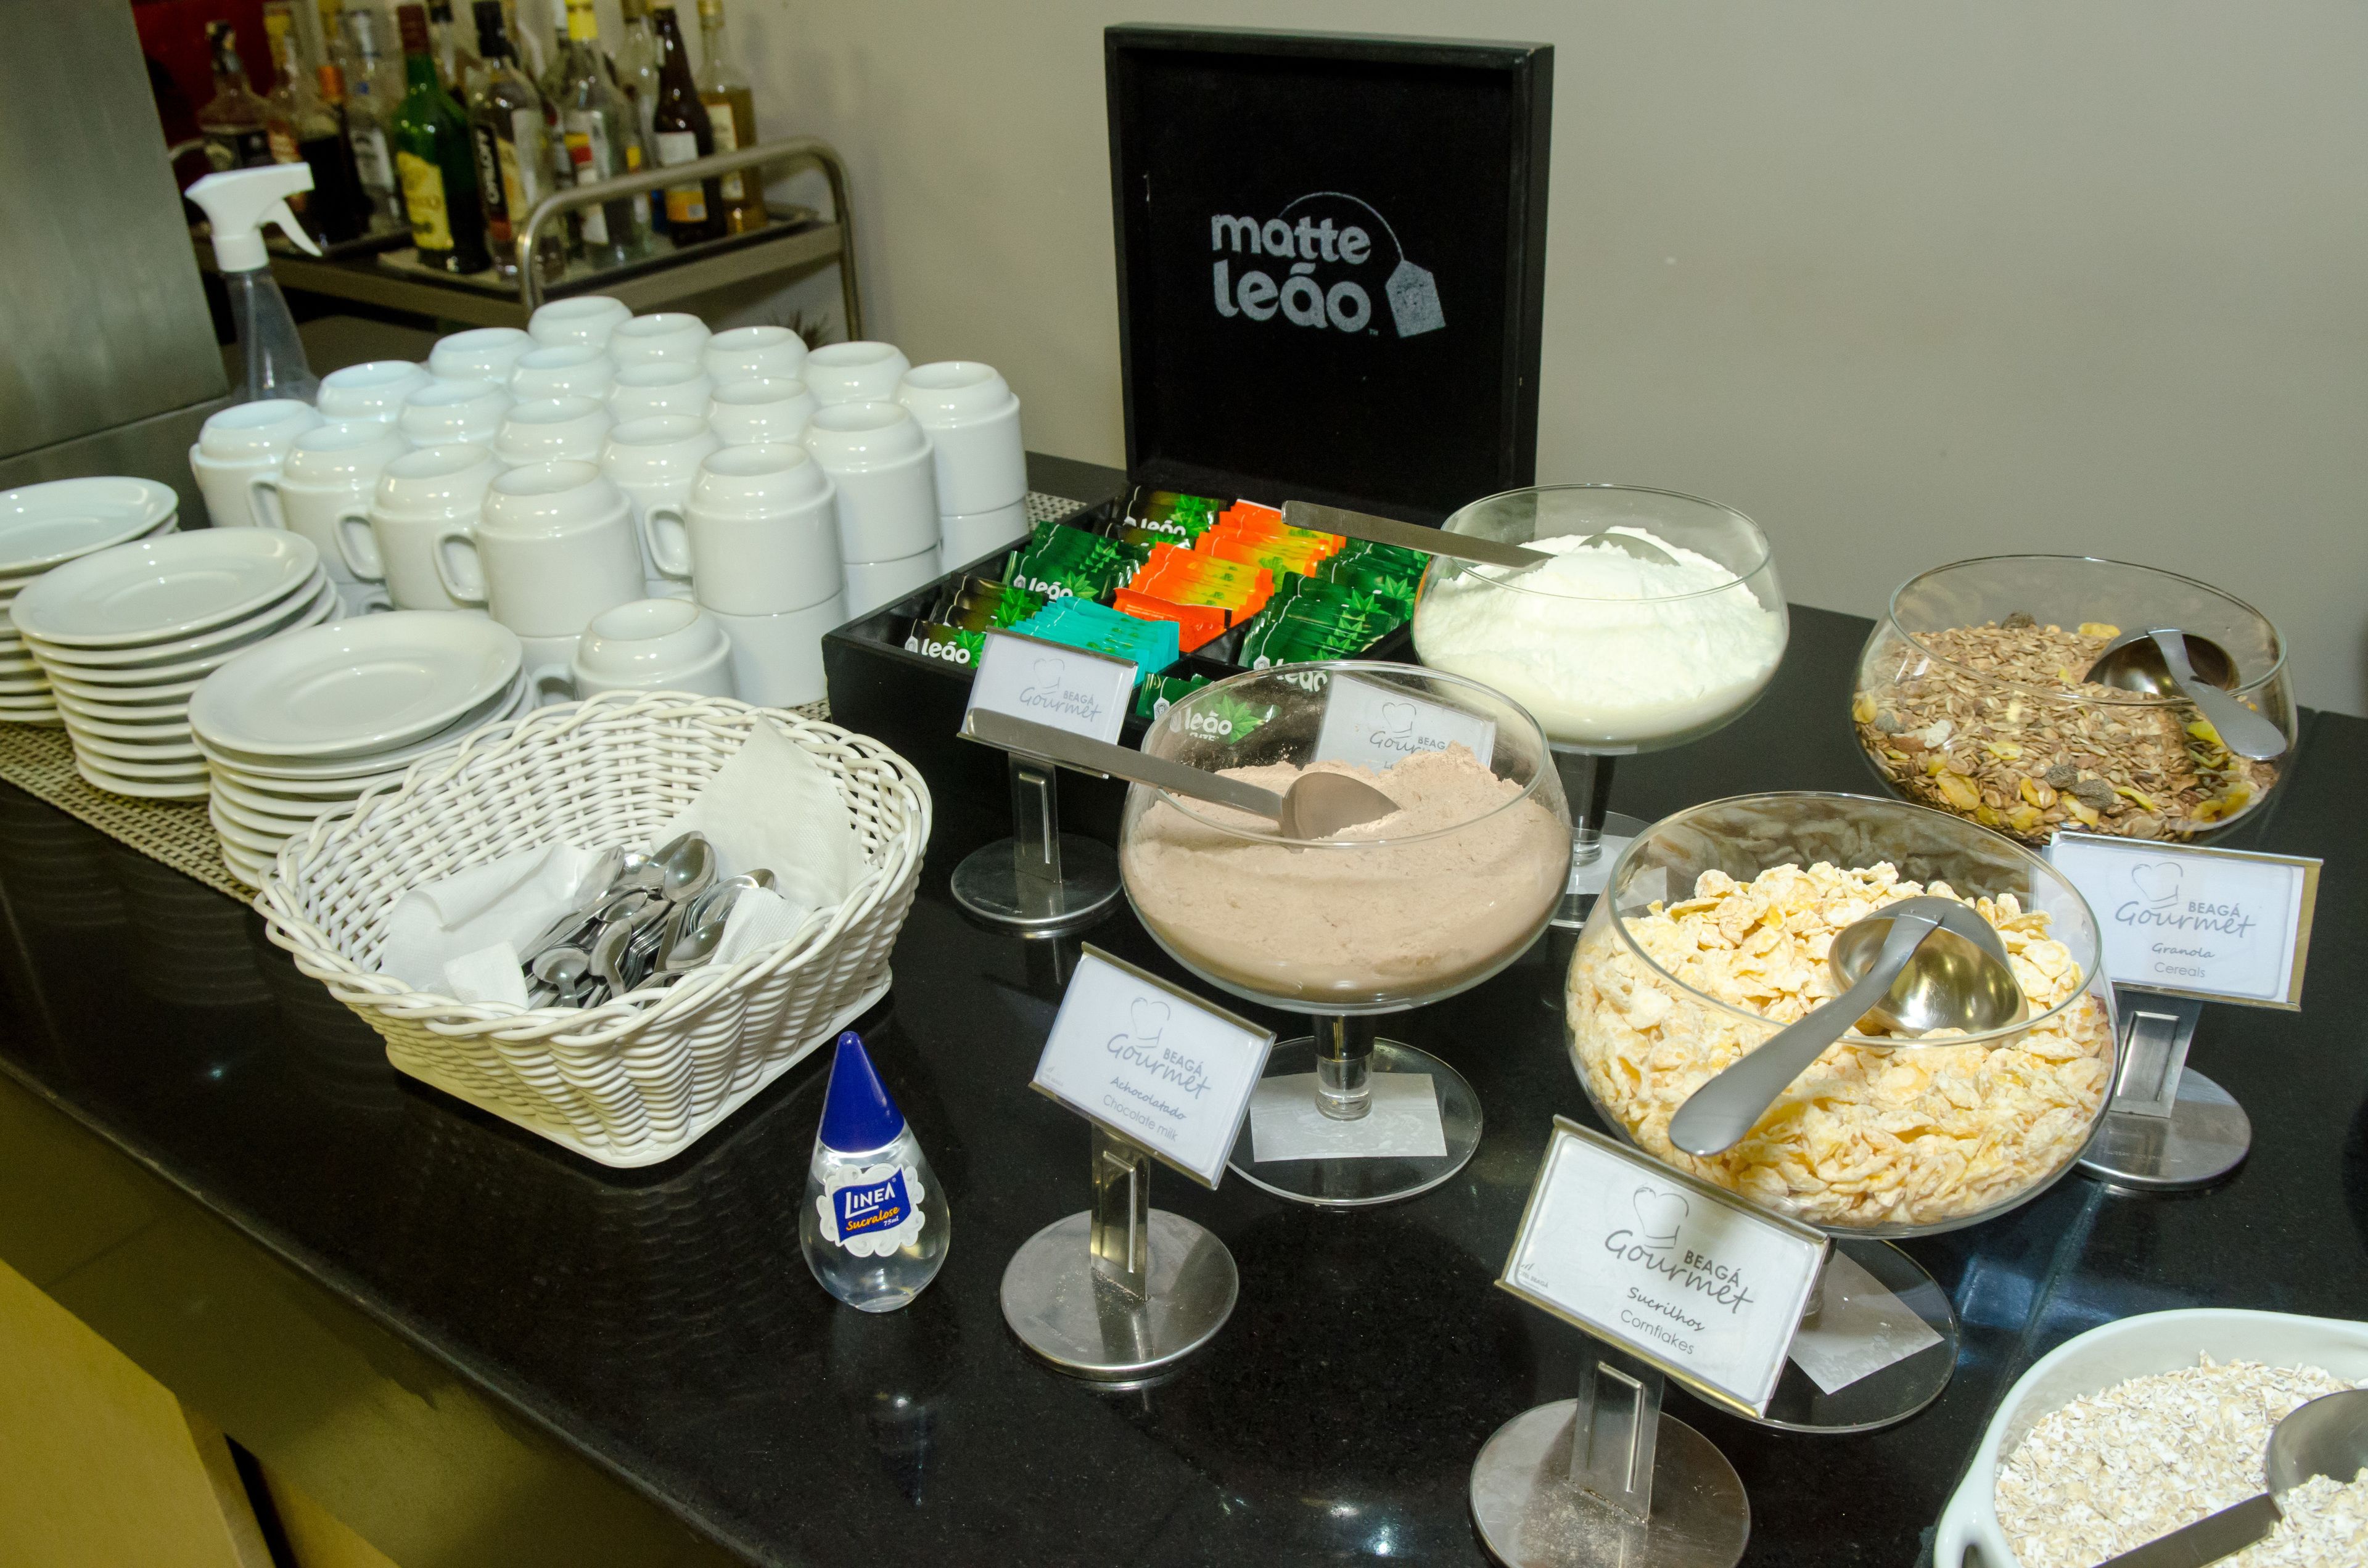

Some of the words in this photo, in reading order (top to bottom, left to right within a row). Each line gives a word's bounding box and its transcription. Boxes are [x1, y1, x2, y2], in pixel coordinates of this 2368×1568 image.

[1211, 213, 1372, 265] matte
[1212, 258, 1372, 333] leão
[921, 638, 971, 664] leão
[1019, 687, 1102, 722] Gourmet
[1063, 690, 1095, 705] BEAGÁ
[1185, 707, 1233, 735] leão
[1370, 731, 1427, 754] Gour
[1418, 736, 1446, 750] BEAG
[2115, 900, 2256, 938] Gourmet
[2188, 901, 2240, 917] BEAGÁ
[2152, 942, 2215, 959] Granola
[2154, 961, 2206, 979] Cereals
[1107, 1033, 1211, 1099] Gourmet
[1162, 1048, 1204, 1077] BEAGÁ
[1110, 1076, 1186, 1120] Achocolatado
[1103, 1094, 1156, 1130] Chocolate
[1157, 1123, 1179, 1142] milk
[845, 1182, 896, 1219] LINEA
[846, 1207, 900, 1231] Sucralose
[883, 1215, 899, 1226] 75ml
[1605, 1229, 1754, 1314] Gourmet
[1684, 1250, 1740, 1287] BEAGÁ
[1627, 1286, 1706, 1331] Sucrilhos
[1621, 1308, 1695, 1356] Cornflakes
